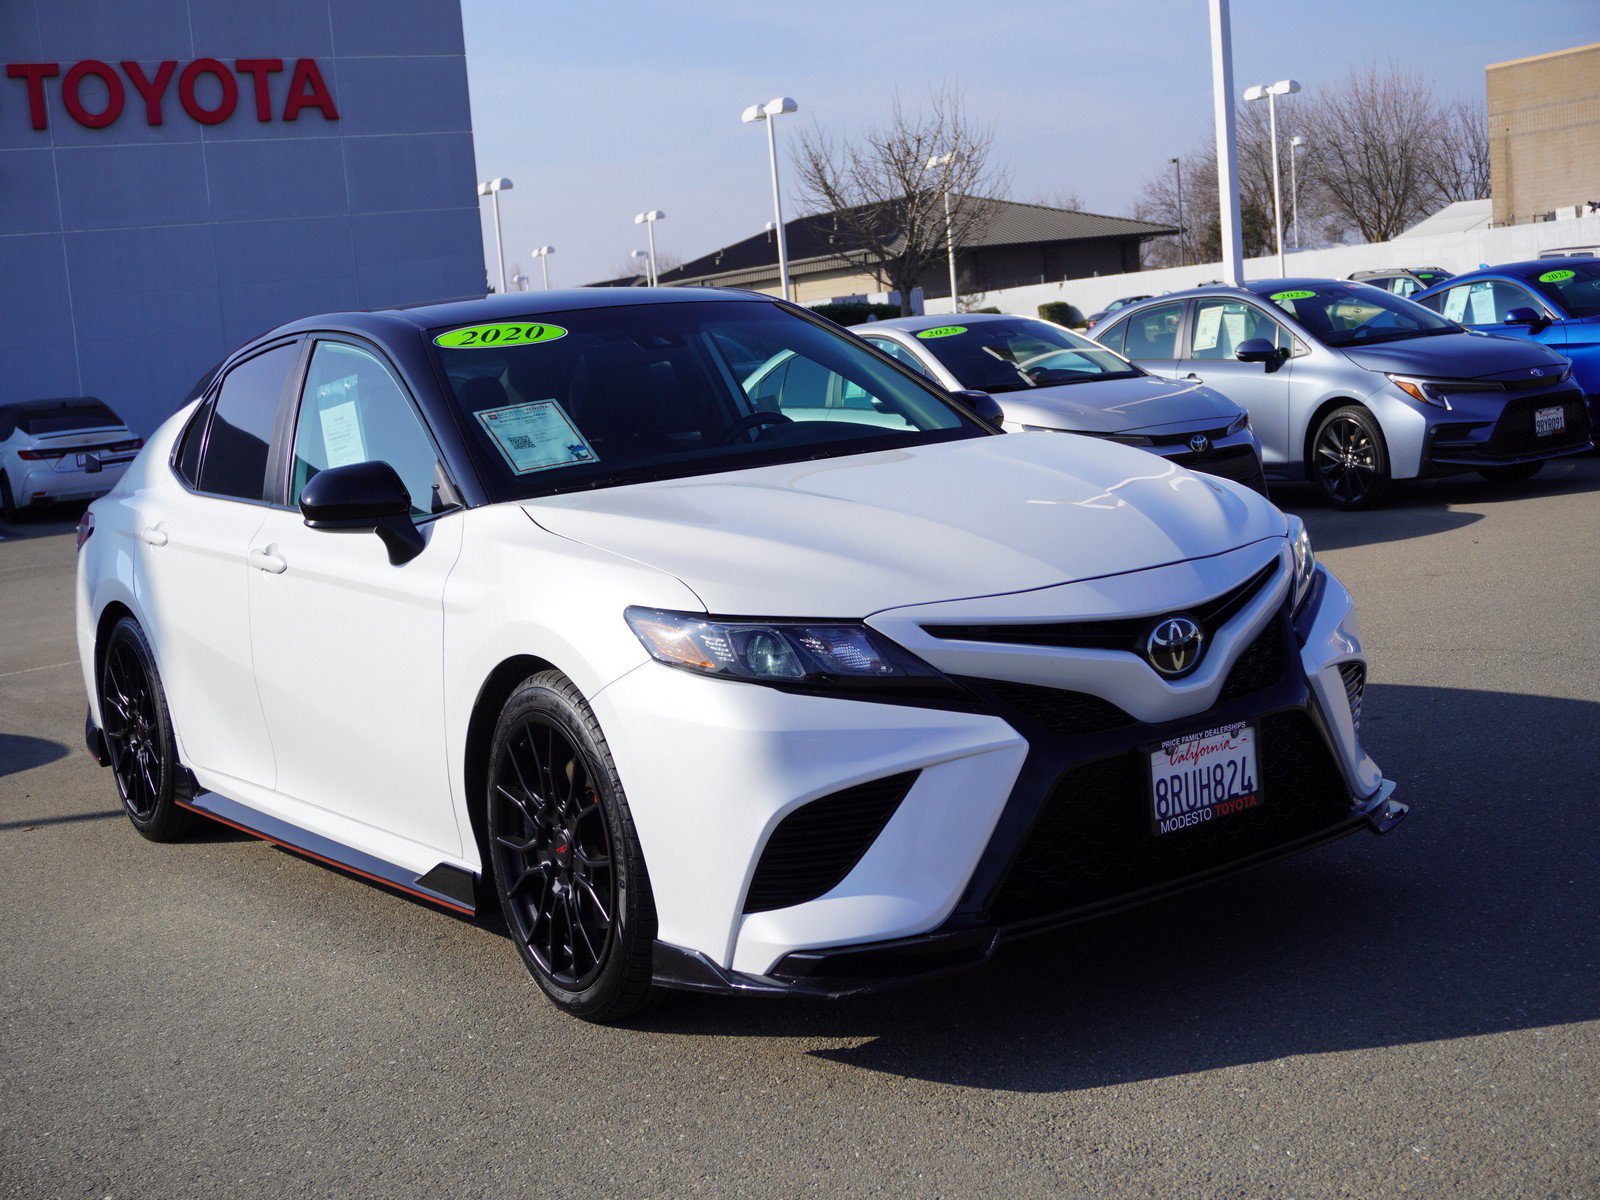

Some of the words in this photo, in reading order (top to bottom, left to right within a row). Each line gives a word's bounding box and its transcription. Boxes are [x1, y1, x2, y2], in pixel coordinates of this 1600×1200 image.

[6, 58, 340, 130] TOYOTA
[458, 325, 545, 346] 2020
[928, 327, 958, 337] 2025
[1161, 738, 1181, 749] PRICE
[1181, 731, 1204, 744] FAMILY
[1204, 721, 1246, 738] DEALERSHIPS
[1169, 738, 1237, 766] California
[1156, 756, 1254, 819] 8RUH824
[1160, 808, 1212, 834] MODESTO
[1214, 795, 1257, 817] TOYOTA
